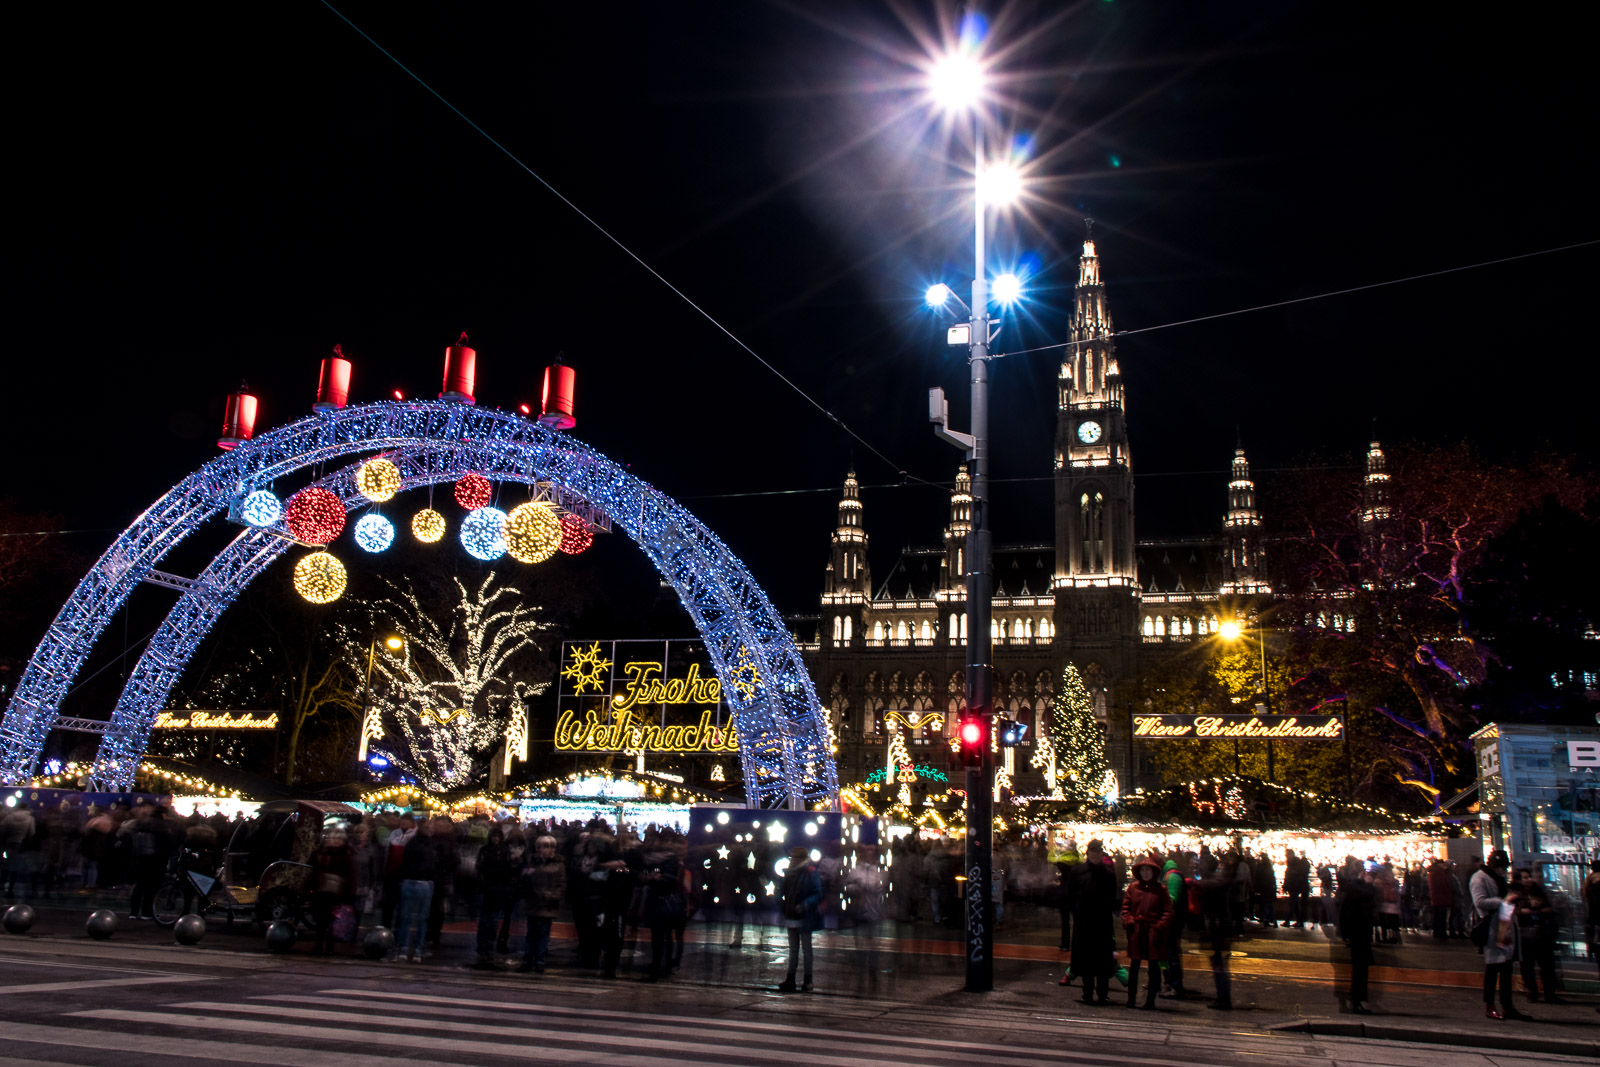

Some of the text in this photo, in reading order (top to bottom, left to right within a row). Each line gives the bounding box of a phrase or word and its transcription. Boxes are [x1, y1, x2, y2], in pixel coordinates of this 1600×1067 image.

[611, 661, 721, 710] Frohe
[153, 711, 279, 729] Wiener Christkindlmarkt
[554, 709, 770, 751] Weihnacht
[1133, 716, 1344, 737] Wiener Christkindlmarkt
